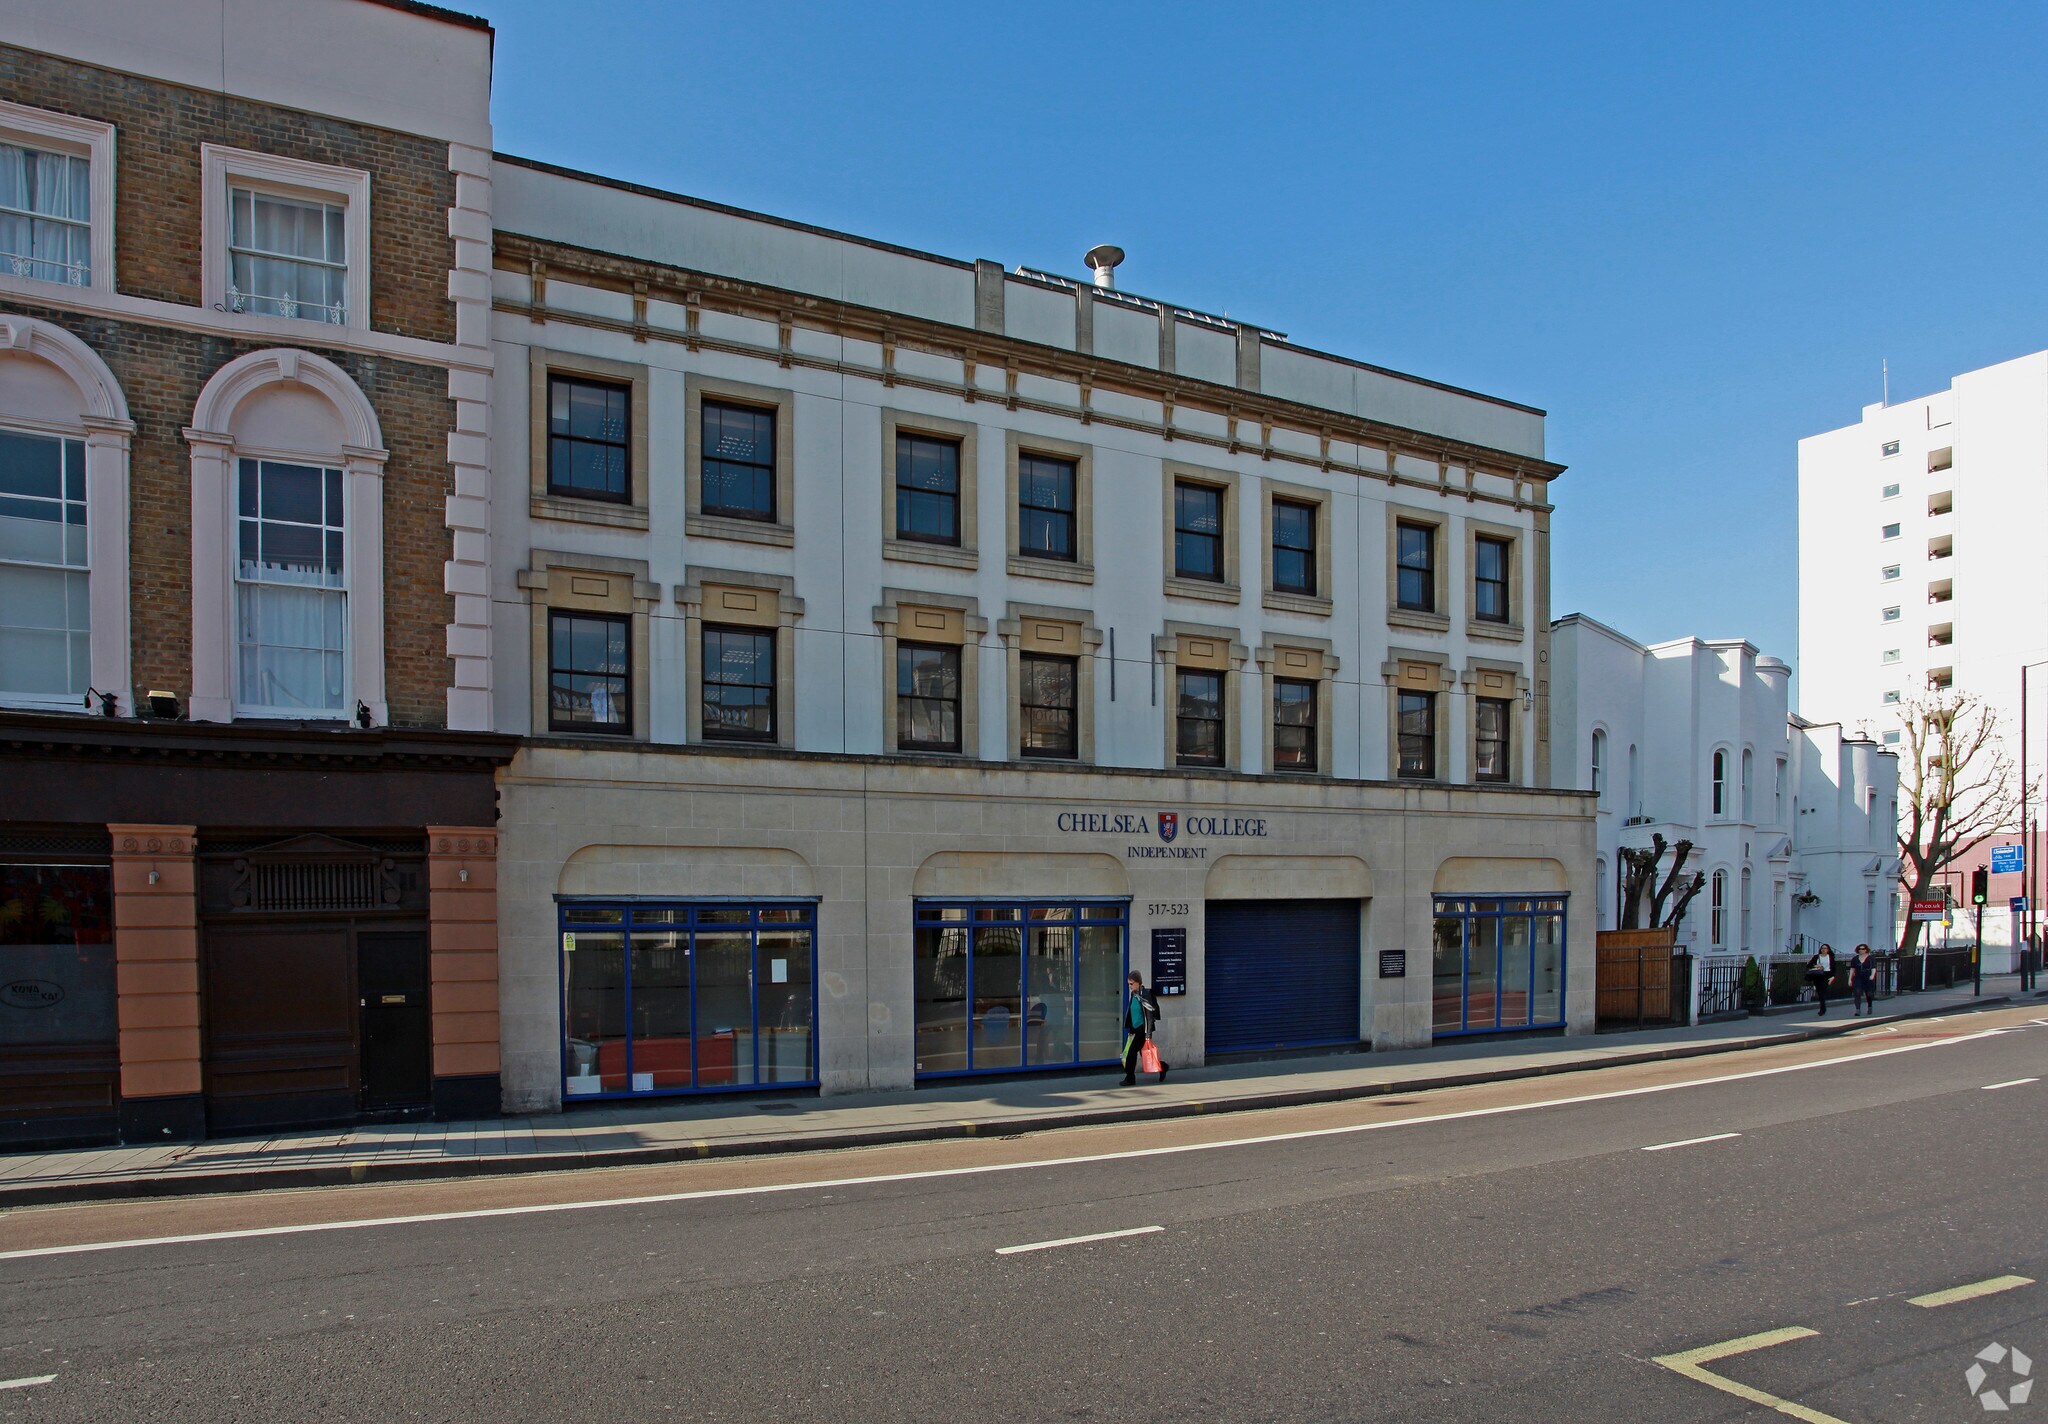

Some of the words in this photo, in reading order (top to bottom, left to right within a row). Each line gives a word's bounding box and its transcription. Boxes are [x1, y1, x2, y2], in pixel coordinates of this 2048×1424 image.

[1057, 812, 1150, 834] CHELSEA
[1186, 816, 1267, 837] COLLEGE
[1127, 846, 1207, 859] INDEPENDENT
[1148, 903, 1189, 916] 517-523
[11, 985, 40, 993] KONA
